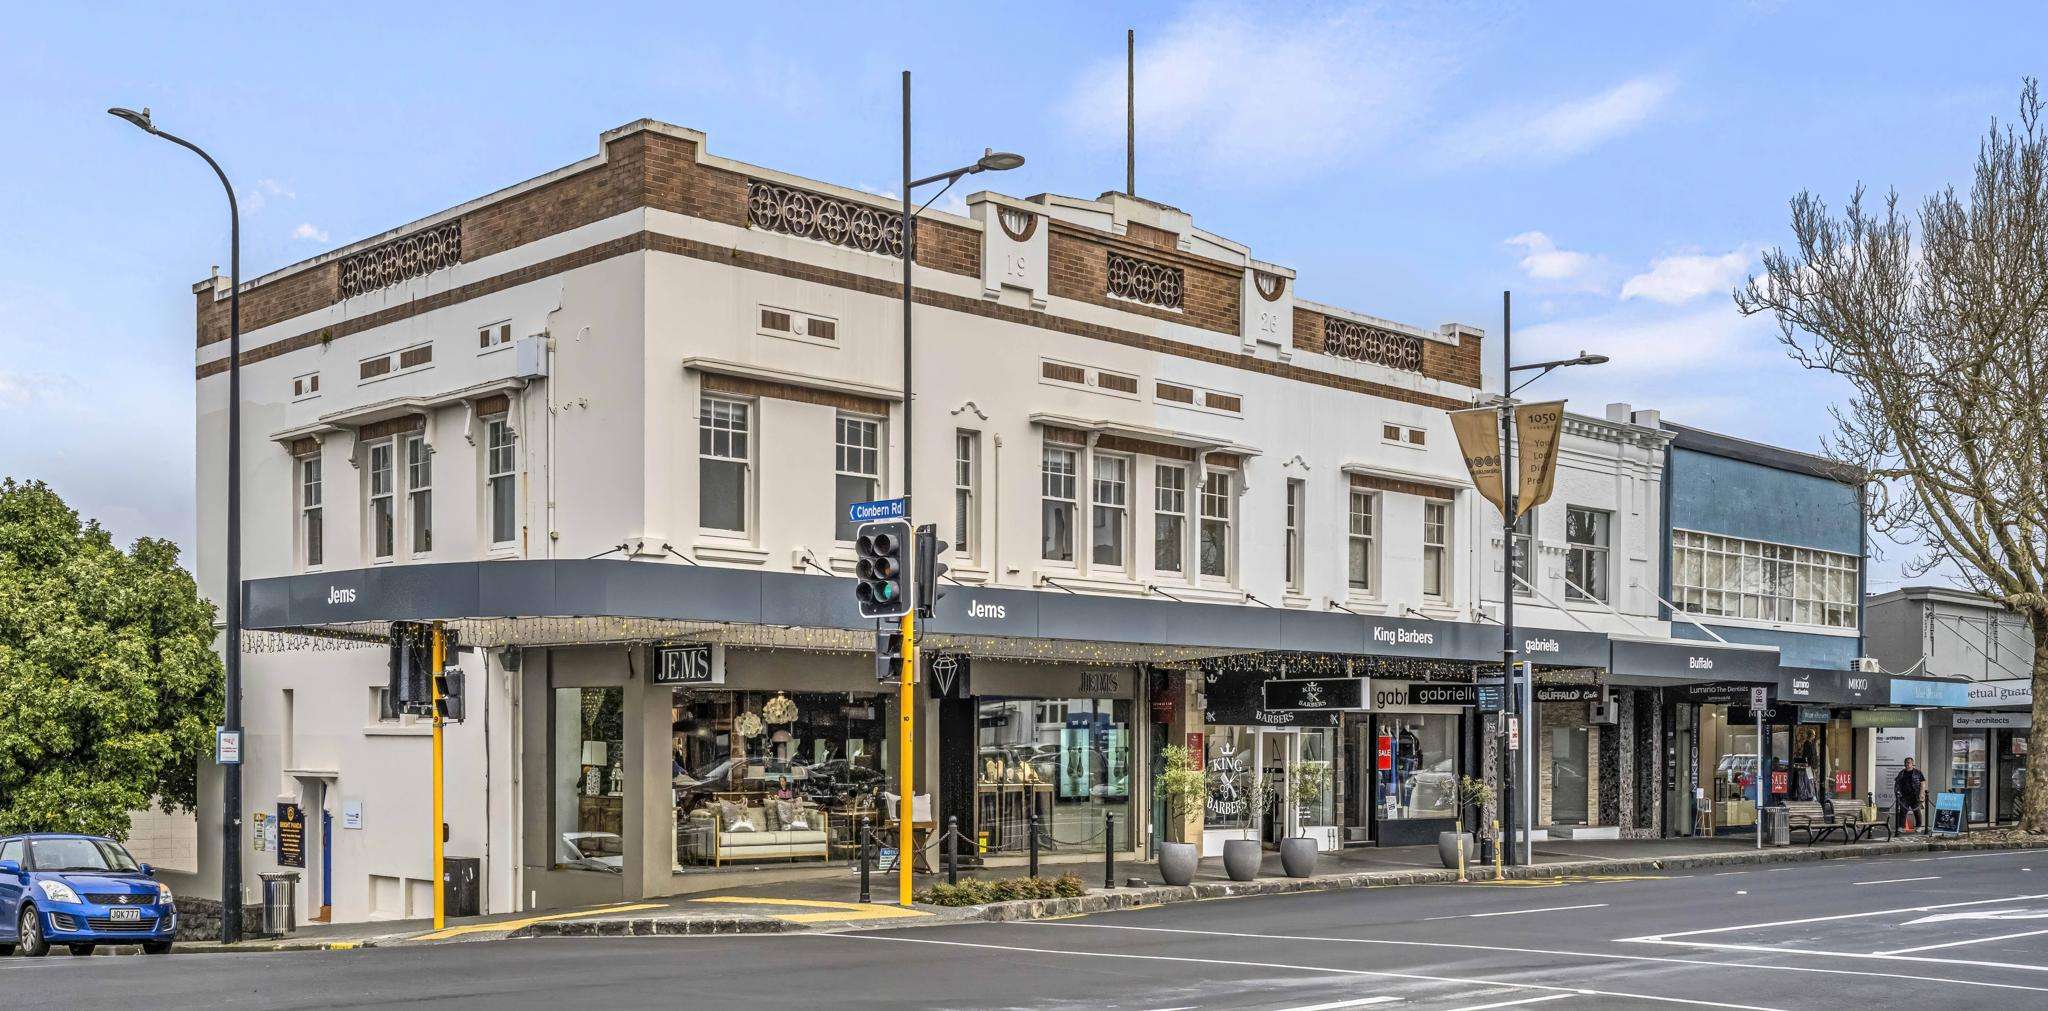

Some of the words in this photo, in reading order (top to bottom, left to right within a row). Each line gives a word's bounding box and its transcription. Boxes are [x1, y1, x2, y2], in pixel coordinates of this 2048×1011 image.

[1528, 412, 1556, 424] 1050
[856, 504, 890, 518] Clonbern
[891, 502, 902, 515] Rd
[327, 585, 356, 605] Jems
[967, 599, 1006, 619] Jems
[1373, 626, 1396, 645] King
[1397, 627, 1433, 645] Barbers
[1525, 637, 1559, 654] gabriella
[658, 647, 709, 681] JEMS
[1689, 656, 1713, 669] Buffalo
[1080, 671, 1120, 695] JEMS
[1690, 684, 1717, 694] Lumino
[1848, 678, 1868, 690] MIKKO
[1968, 686, 1997, 699] etual
[1298, 700, 1327, 708] BARBERS
[1255, 710, 1294, 724] BARBERS
[1748, 709, 1777, 718] MKKO
[1378, 749, 1392, 757] SALE
[1213, 757, 1243, 772] KING
[1771, 774, 1788, 785] SALE
[1835, 774, 1852, 784] SALE
[1206, 795, 1248, 815] BARBERS
